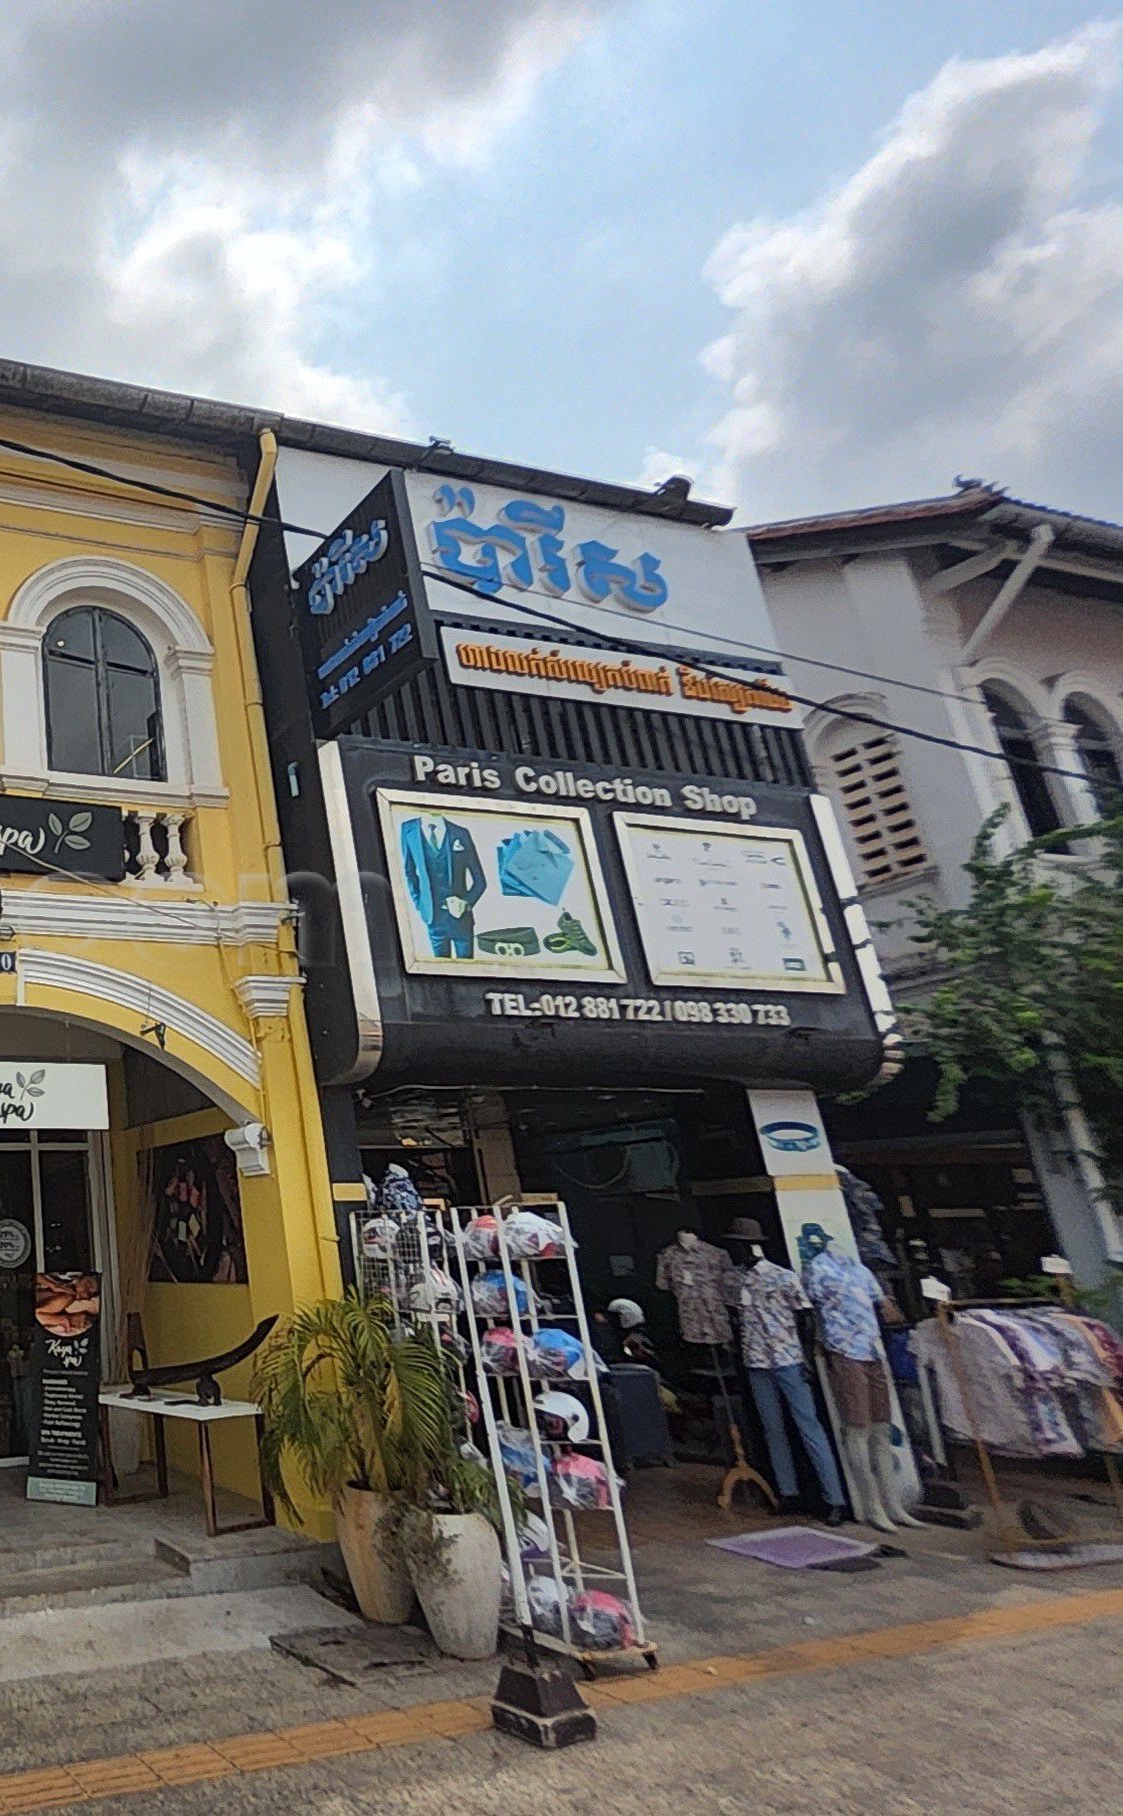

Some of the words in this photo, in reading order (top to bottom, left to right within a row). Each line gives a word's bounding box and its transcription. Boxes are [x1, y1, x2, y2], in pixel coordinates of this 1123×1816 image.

[413, 755, 501, 789] Paris
[515, 766, 673, 808] Collection
[680, 784, 758, 821] Shop
[580, 996, 621, 1020] 881
[619, 998, 663, 1021] 722
[673, 1000, 713, 1023] 098
